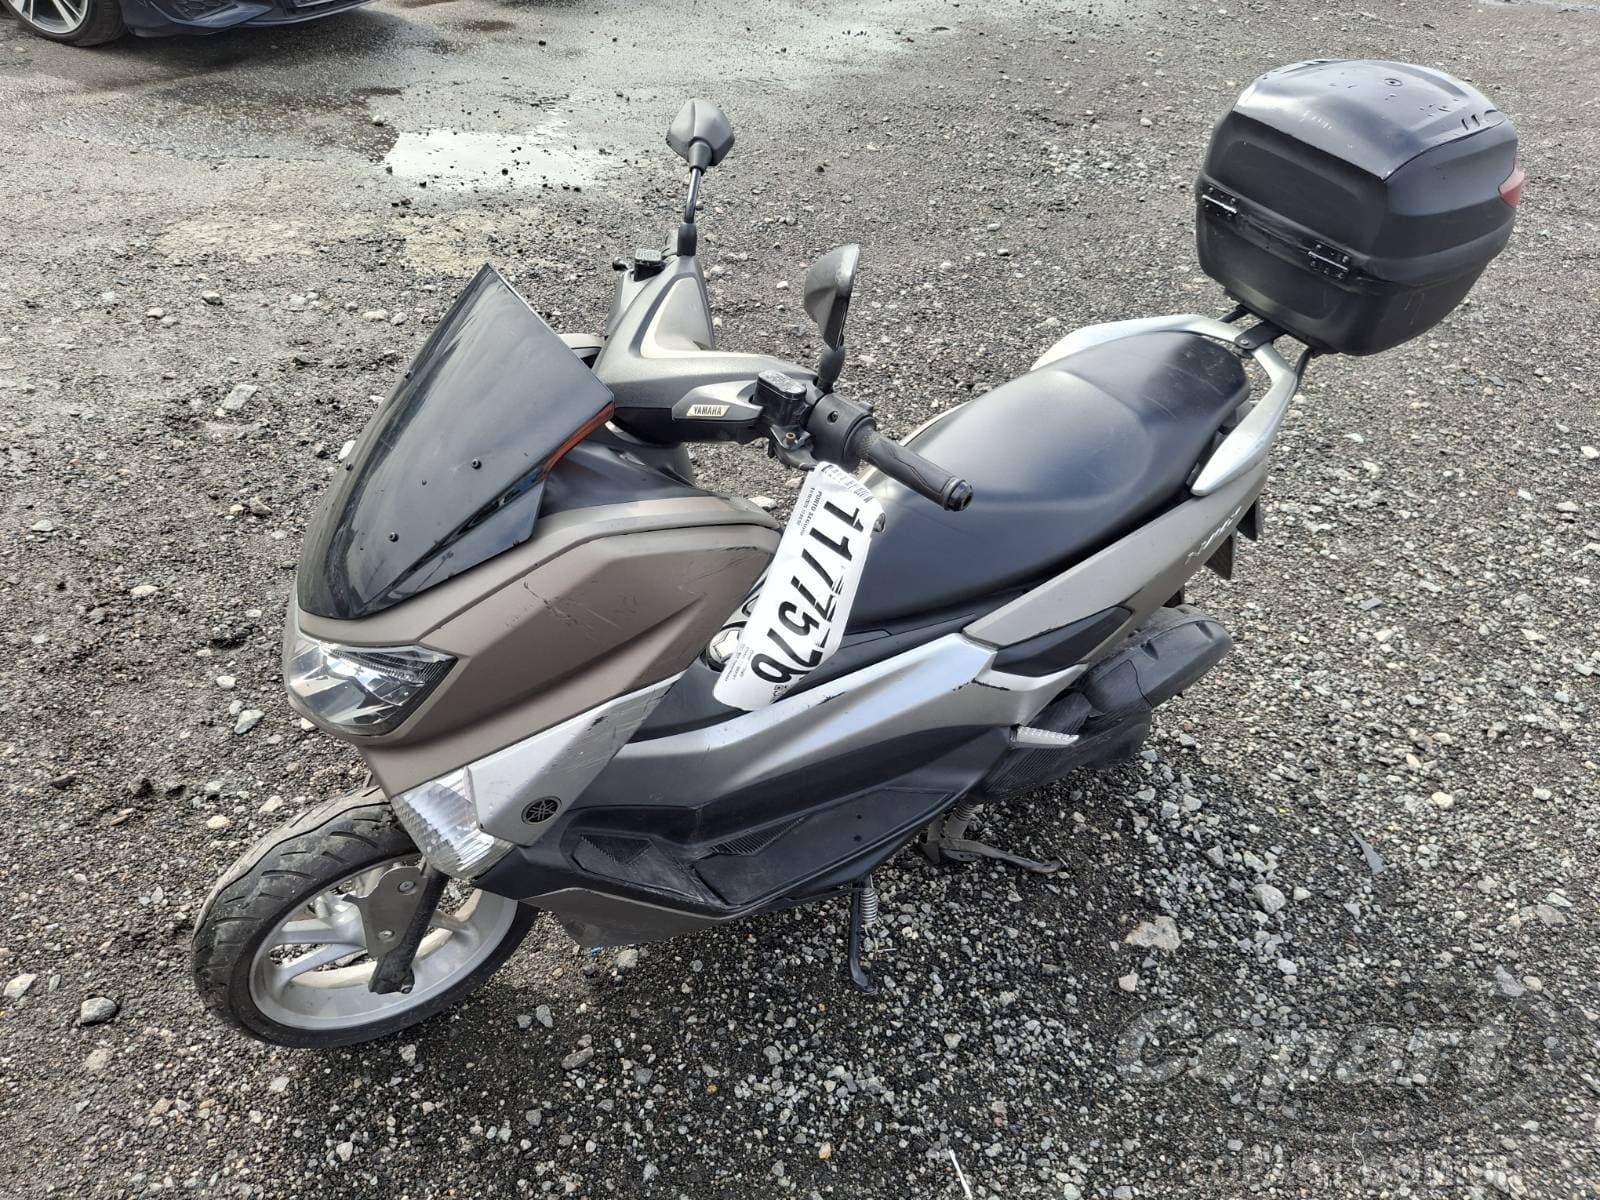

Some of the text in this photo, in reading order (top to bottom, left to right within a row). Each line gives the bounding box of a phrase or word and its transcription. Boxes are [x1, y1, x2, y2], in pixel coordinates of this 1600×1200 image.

[693, 406, 722, 415] YAMAHA
[810, 491, 822, 512] PORTO
[750, 500, 865, 683] 1177576
